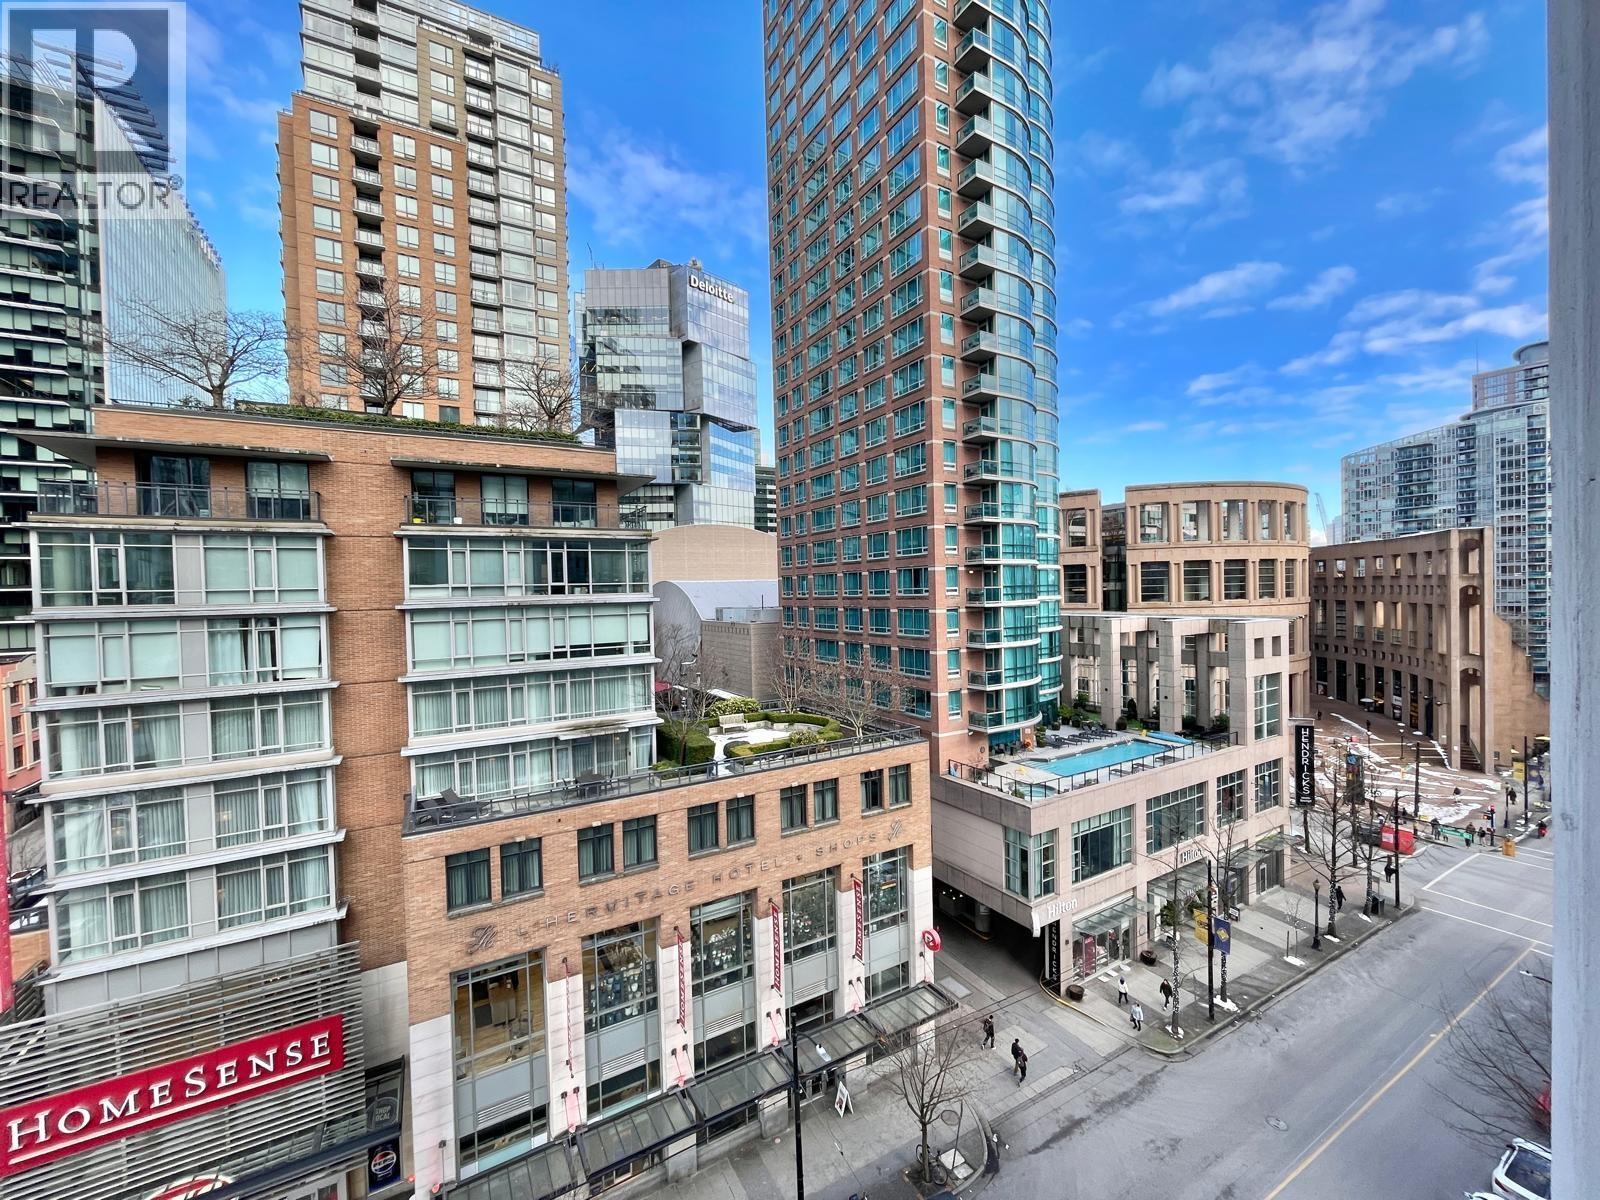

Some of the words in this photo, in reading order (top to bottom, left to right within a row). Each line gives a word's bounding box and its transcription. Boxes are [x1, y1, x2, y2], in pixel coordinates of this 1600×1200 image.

[1301, 727, 1311, 795] HENDRICKS
[712, 858, 782, 884] HOTEL
[815, 832, 876, 856] SHOPS
[1048, 898, 1078, 919] Hilton
[6, 1031, 331, 1152] HOMESENSE
